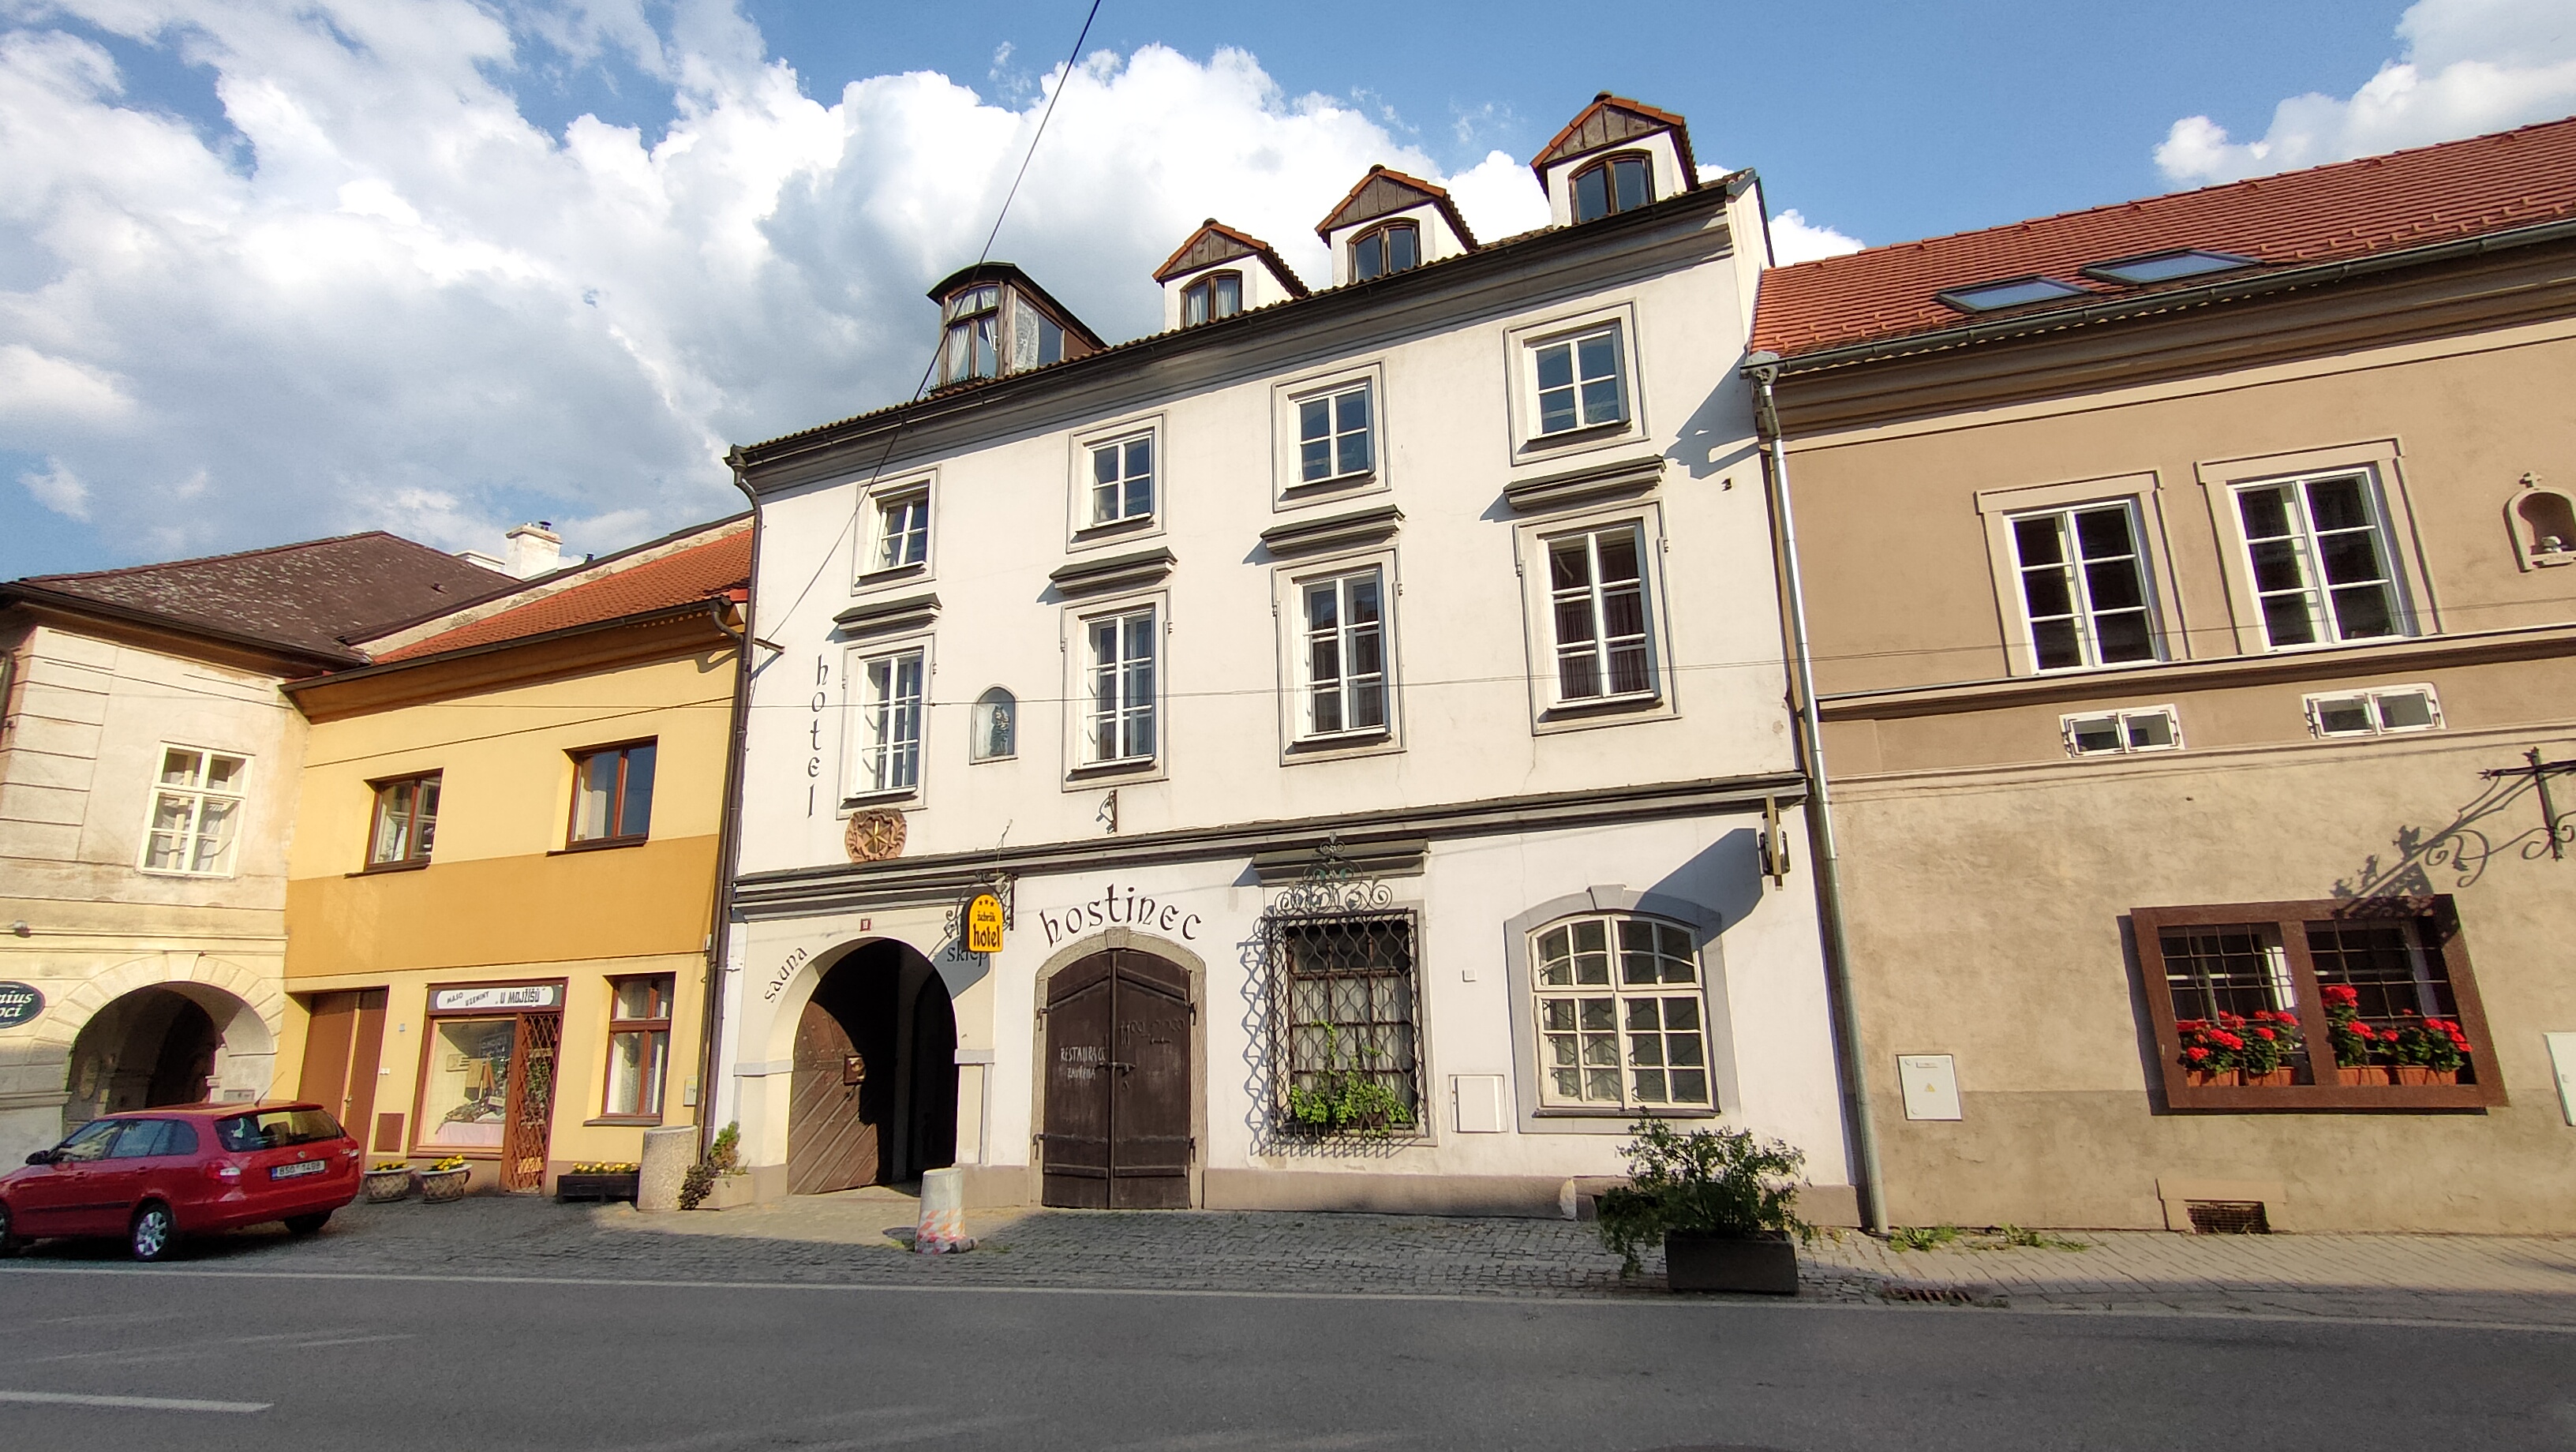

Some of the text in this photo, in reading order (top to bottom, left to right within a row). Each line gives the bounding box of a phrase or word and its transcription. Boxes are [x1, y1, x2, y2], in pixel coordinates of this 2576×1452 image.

[807, 654, 828, 818] hotel
[973, 923, 1000, 948] hotel
[1039, 883, 1201, 948] hostinec
[447, 992, 464, 1004] MASO
[764, 947, 807, 1003] sauna
